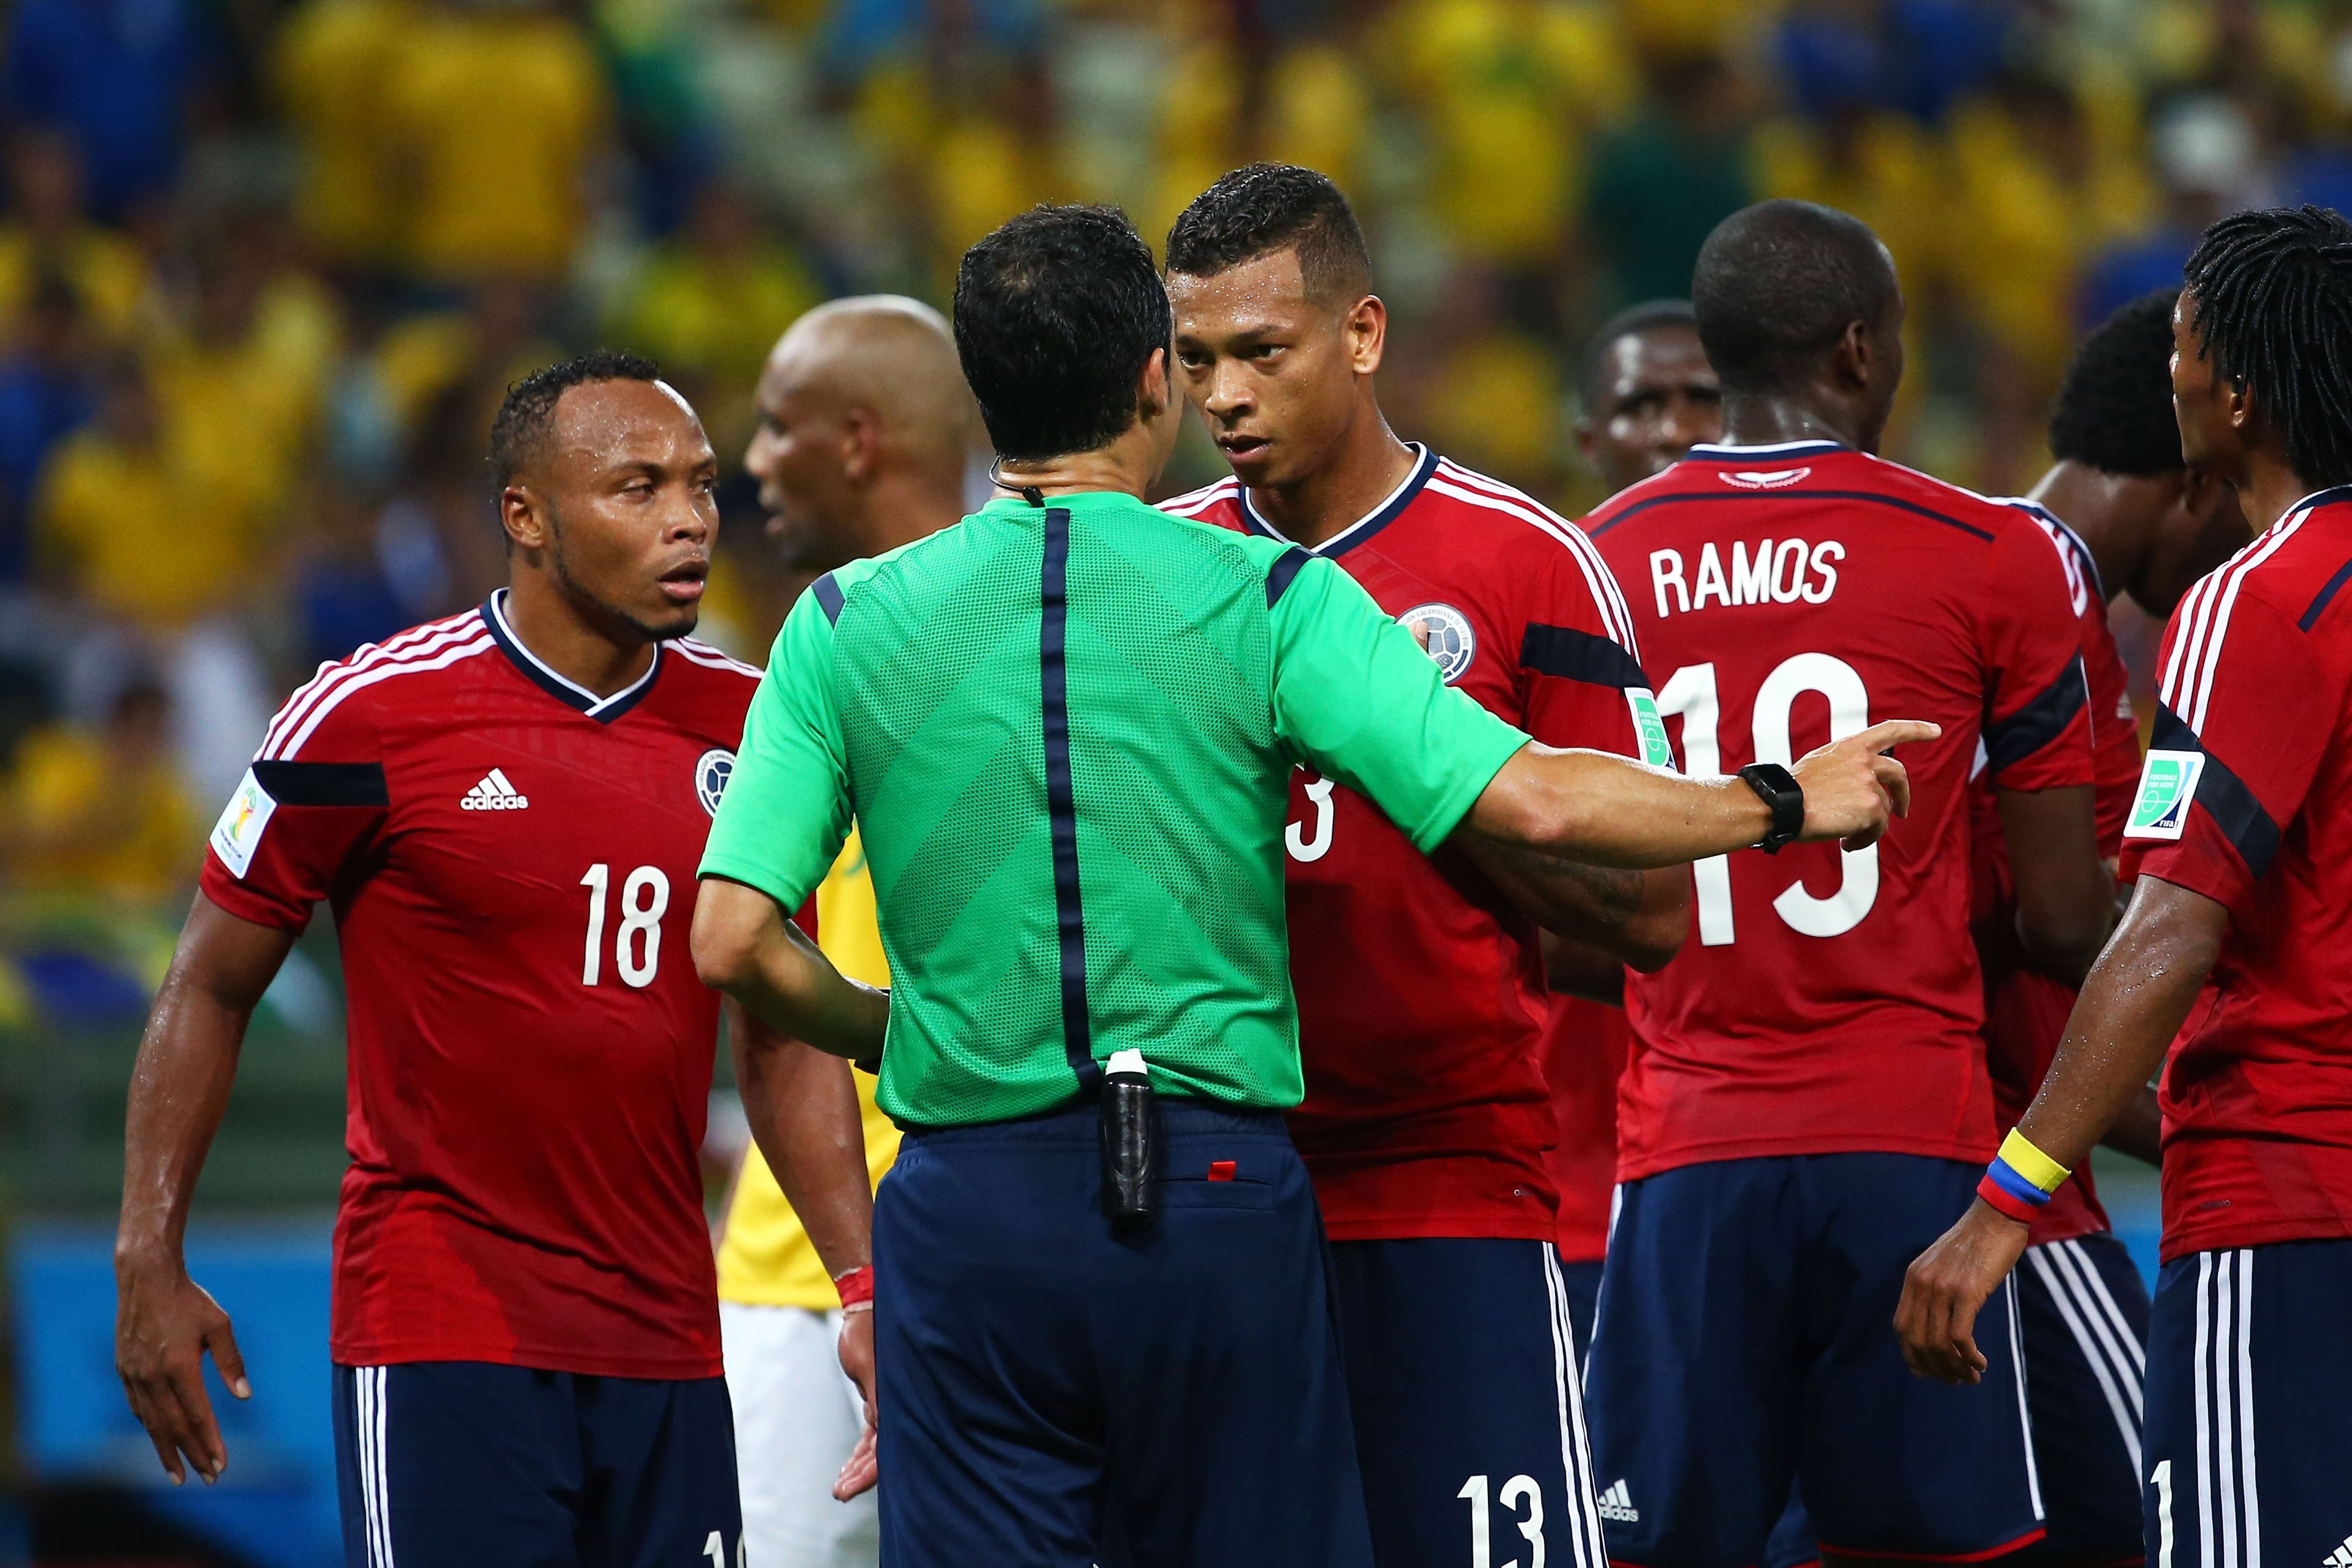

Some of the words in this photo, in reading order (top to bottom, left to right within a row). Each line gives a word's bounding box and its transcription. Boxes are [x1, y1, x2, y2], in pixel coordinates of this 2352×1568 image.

[1649, 537, 1847, 619] RAMOS
[460, 794, 529, 810] adidas
[1655, 651, 1880, 947] 19
[2159, 819, 2174, 828] FIFA
[579, 863, 670, 988] 18
[1456, 1474, 1545, 1568] 13
[1599, 1505, 1639, 1522] didas
